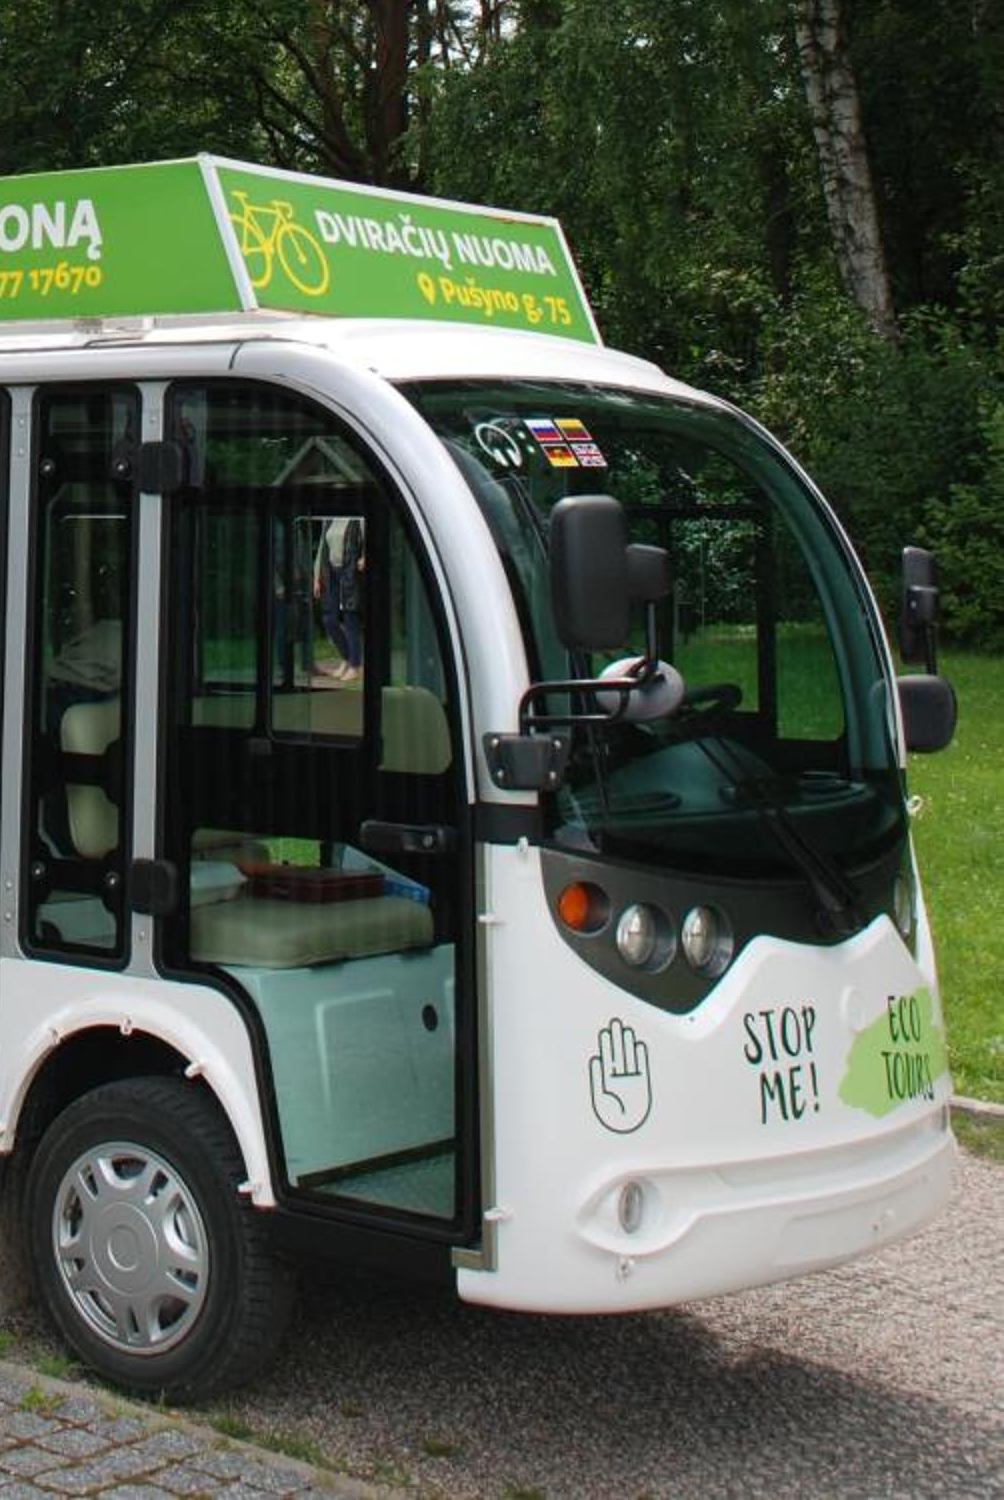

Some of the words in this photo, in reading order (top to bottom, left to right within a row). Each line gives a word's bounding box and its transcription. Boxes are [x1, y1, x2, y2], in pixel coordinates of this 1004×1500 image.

[314, 210, 452, 270] DVIRAČIŲ
[452, 233, 556, 276] NUOMA
[29, 261, 102, 295] 17670
[440, 277, 519, 317] Pušyno
[523, 294, 544, 324] g.
[544, 298, 572, 325] 75
[743, 1006, 816, 1065] STOP
[887, 996, 921, 1043] ECO
[760, 1061, 820, 1124] ME!
[881, 1051, 935, 1100] TOURS
